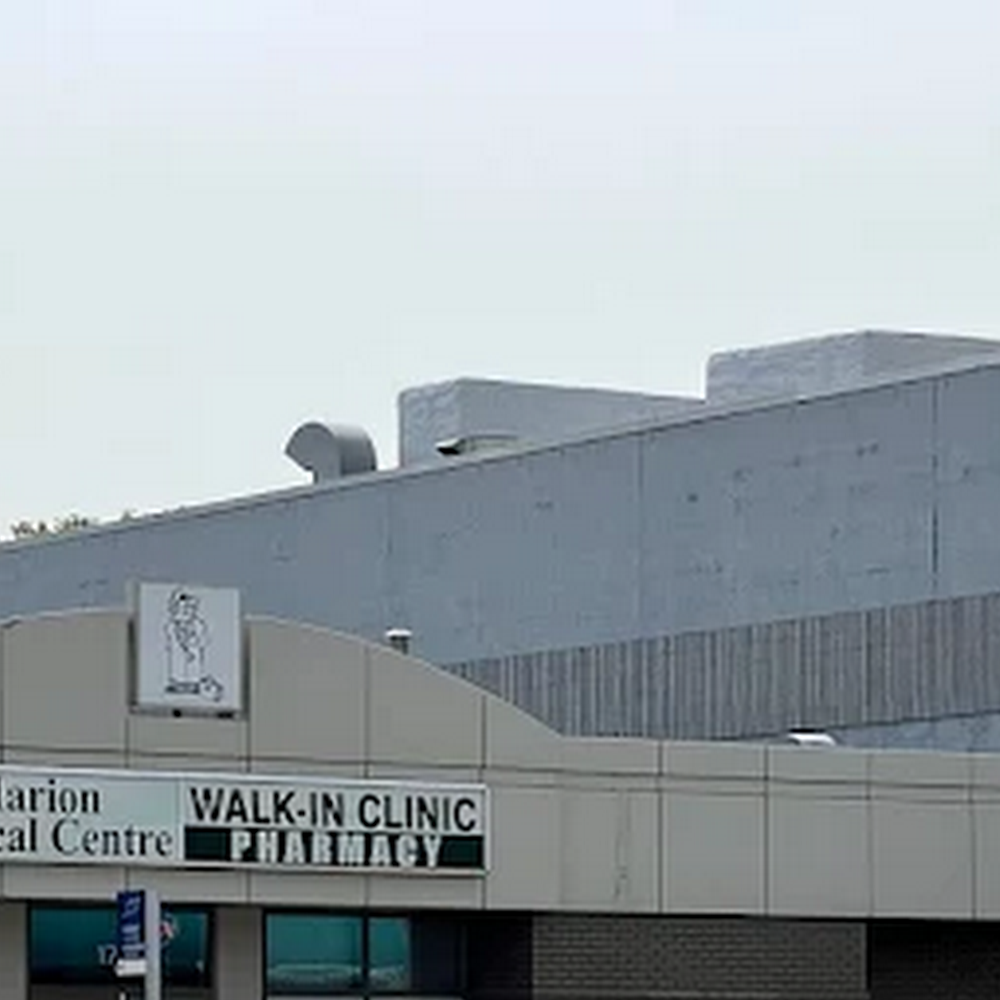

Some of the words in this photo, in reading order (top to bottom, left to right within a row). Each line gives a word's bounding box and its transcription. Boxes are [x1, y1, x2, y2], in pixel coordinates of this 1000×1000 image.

[190, 787, 345, 828] WALK-IN
[357, 793, 477, 832] CLINIC
[51, 818, 173, 857] Centre
[230, 829, 443, 868] PHARMACY
